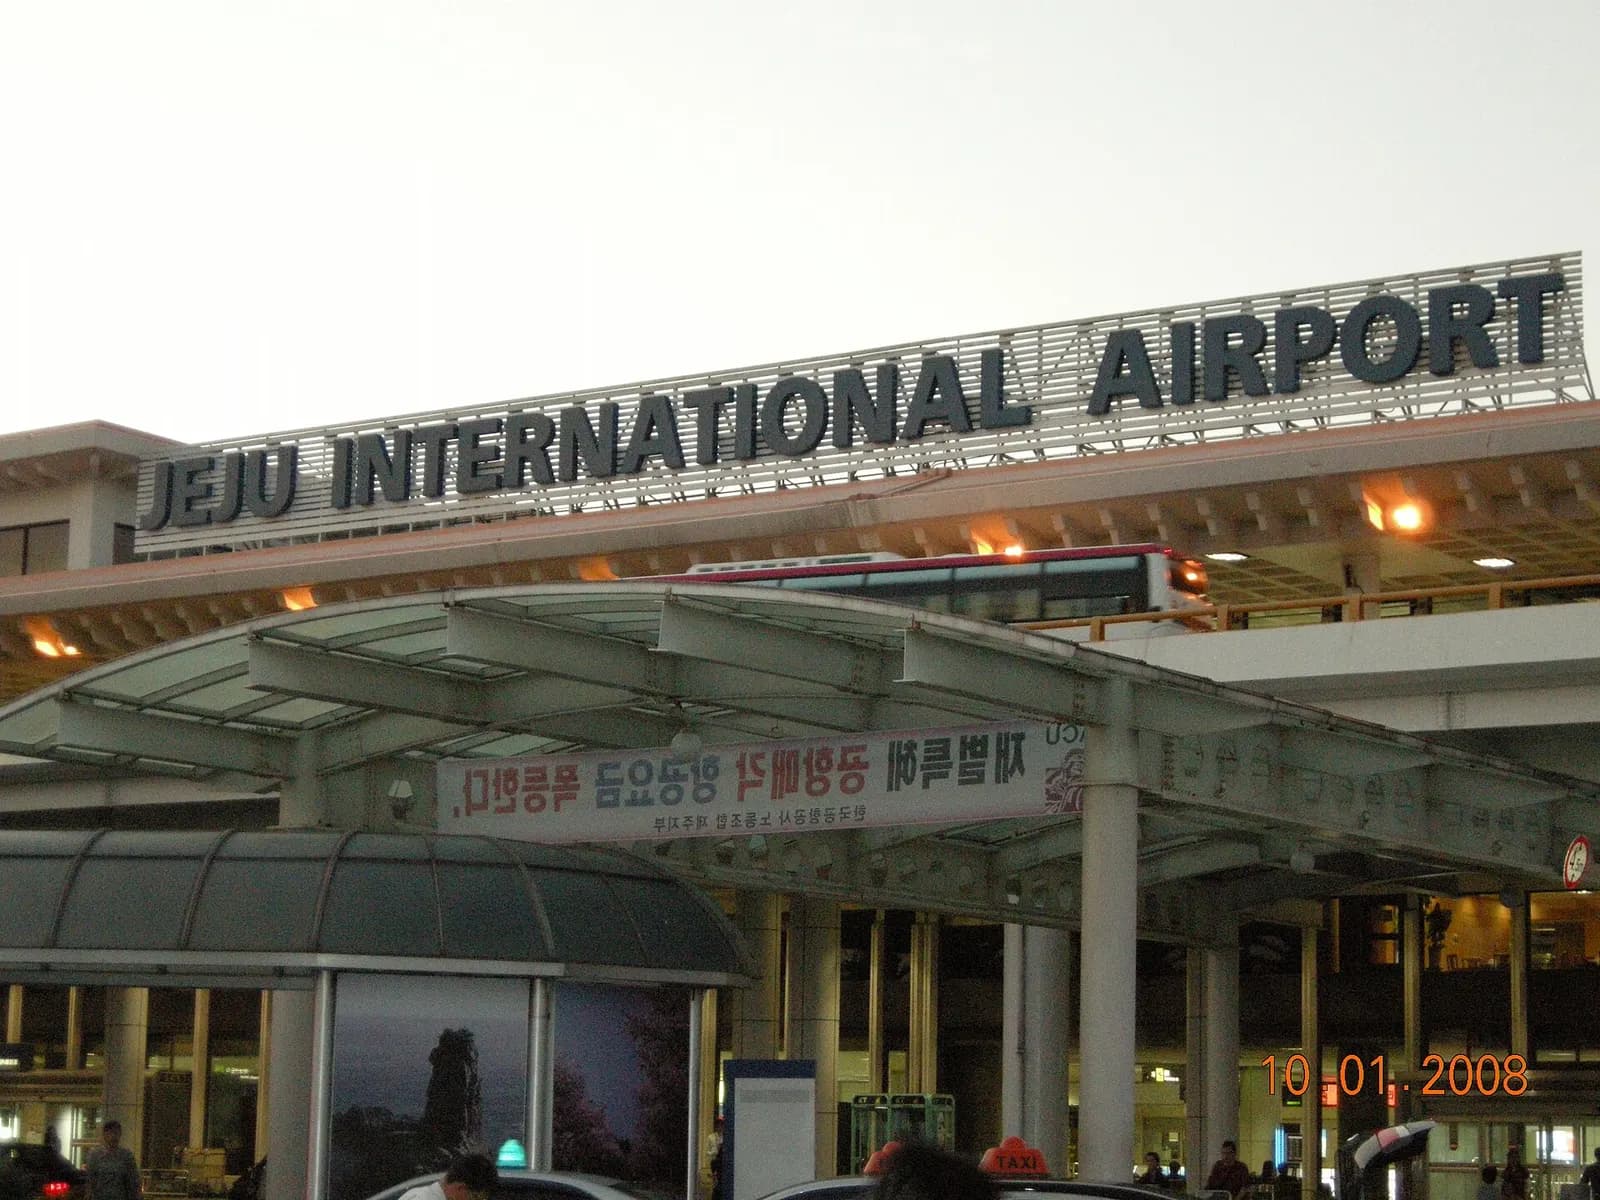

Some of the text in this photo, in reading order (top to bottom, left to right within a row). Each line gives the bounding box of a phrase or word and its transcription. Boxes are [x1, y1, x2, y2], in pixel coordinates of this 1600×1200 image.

[140, 272, 1565, 531] JEJU INTERNATIONAL AIRPORT
[996, 1155, 1037, 1169] TAXI
